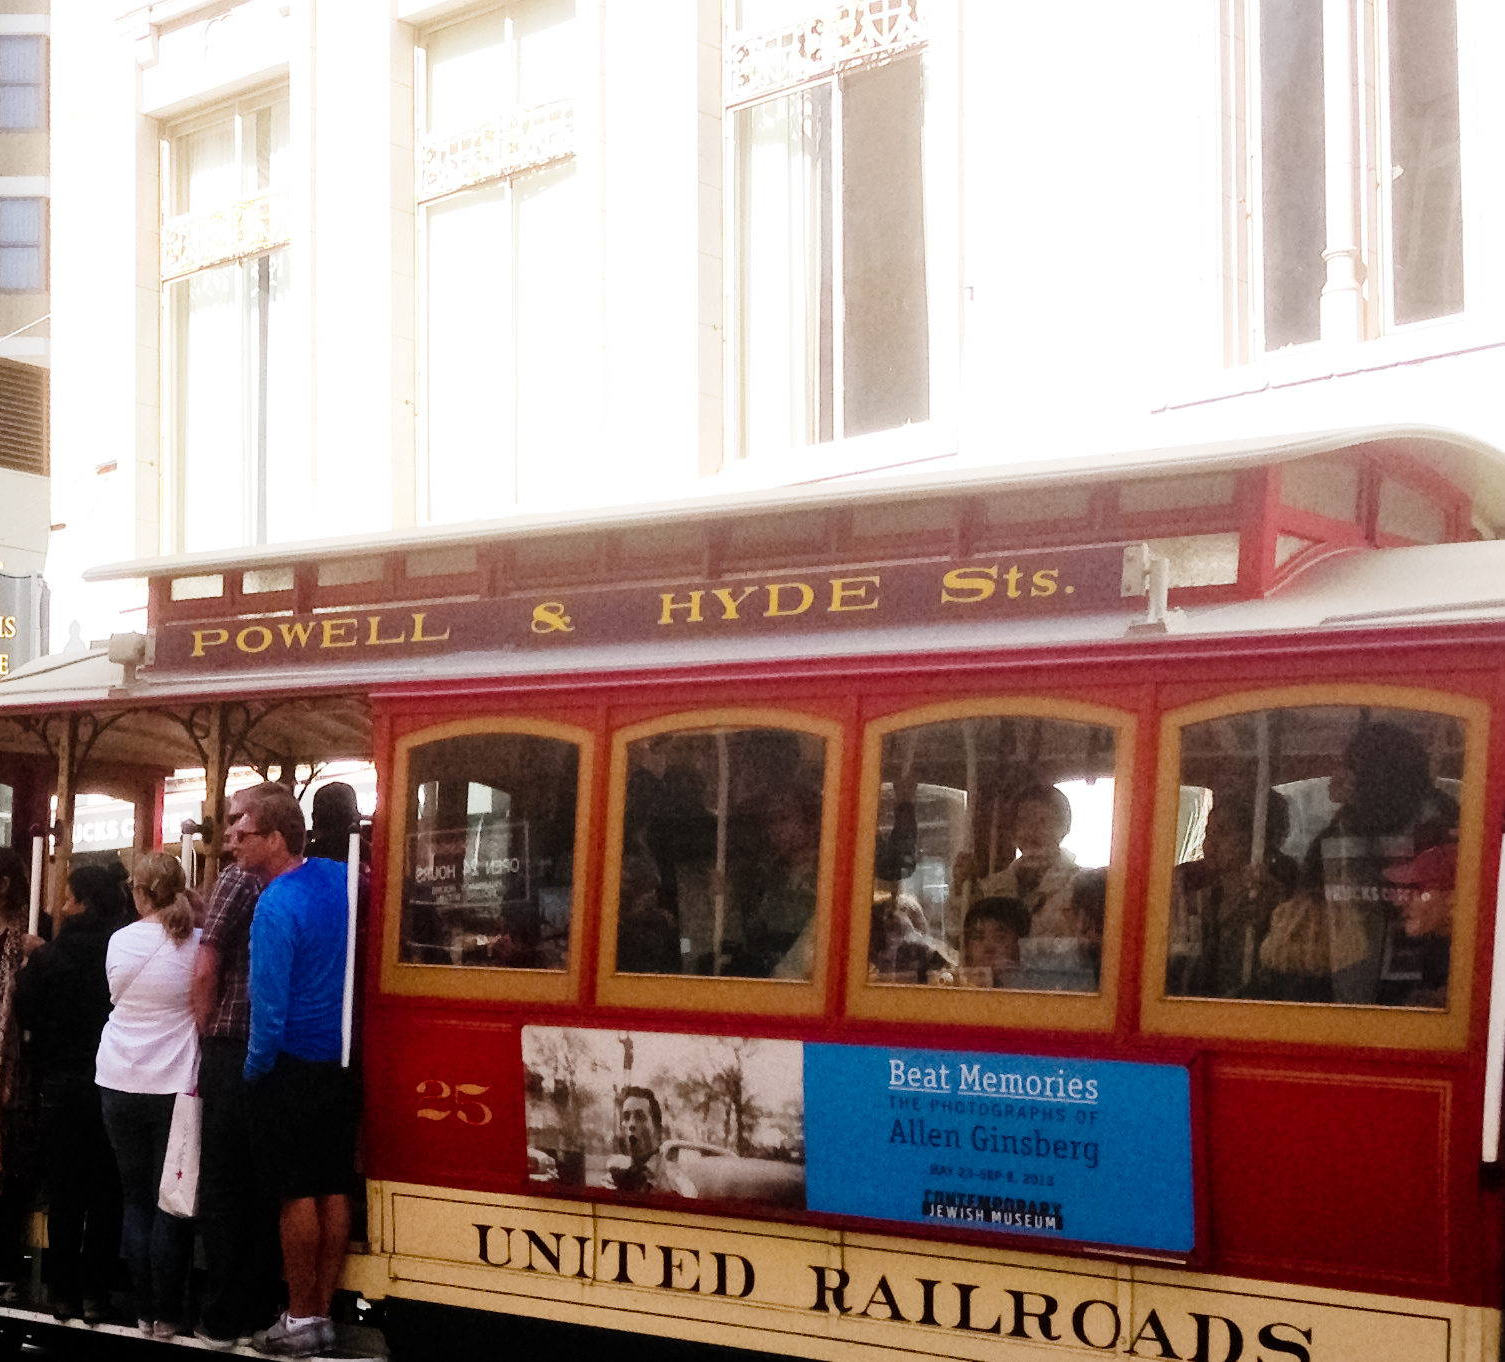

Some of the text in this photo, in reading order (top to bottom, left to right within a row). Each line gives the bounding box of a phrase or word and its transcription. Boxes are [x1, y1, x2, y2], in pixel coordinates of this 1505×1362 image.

[190, 565, 1076, 657] POWELL & HYDE Sts.
[889, 1059, 1100, 1101] Beat Memories
[416, 1079, 492, 1126] 25
[891, 1096, 1099, 1125] THE PHOTOGRAPHS OF
[890, 1119, 1100, 1168] Allen Ginsberg
[930, 1164, 953, 1175] MAY
[1023, 1174, 1054, 1187] 2013
[929, 1203, 1057, 1230] JEWISH MUSEUM
[471, 1223, 1314, 1362] UNITED RAILROADS
